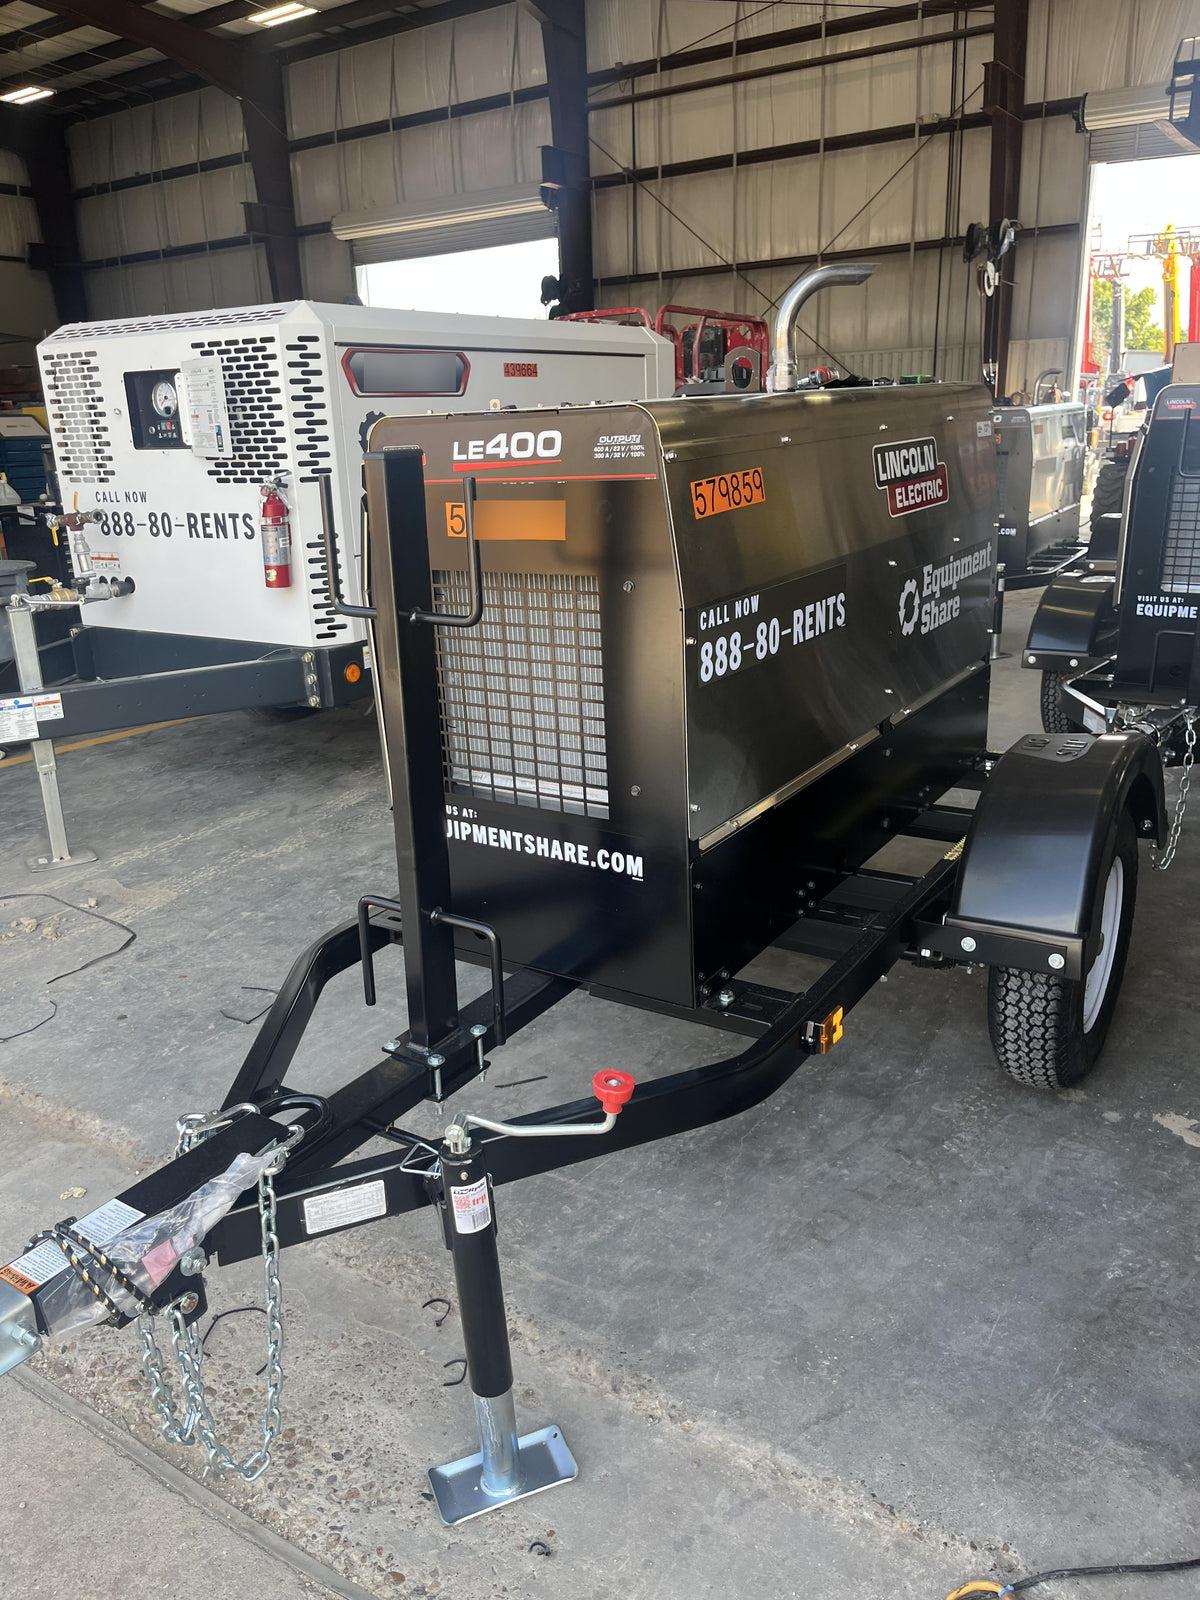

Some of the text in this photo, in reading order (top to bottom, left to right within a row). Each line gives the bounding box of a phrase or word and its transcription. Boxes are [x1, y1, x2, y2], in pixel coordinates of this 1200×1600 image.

[504, 363, 537, 377] 439664
[453, 430, 562, 461] LE400
[599, 434, 638, 443] OUTPUT
[877, 444, 935, 481] LINCOLN
[95, 491, 147, 503] CALL NOW
[694, 469, 764, 516] 579859
[895, 478, 943, 508] ELECTRIC
[100, 511, 256, 540] 888-80-RENTS
[922, 541, 992, 598] Equipment
[700, 594, 760, 630] CALL NOW
[920, 595, 960, 635] Share
[1136, 603, 1198, 618] EQUIPME
[700, 592, 846, 683] 888-80-RENTS
[445, 804, 478, 818] US AT:
